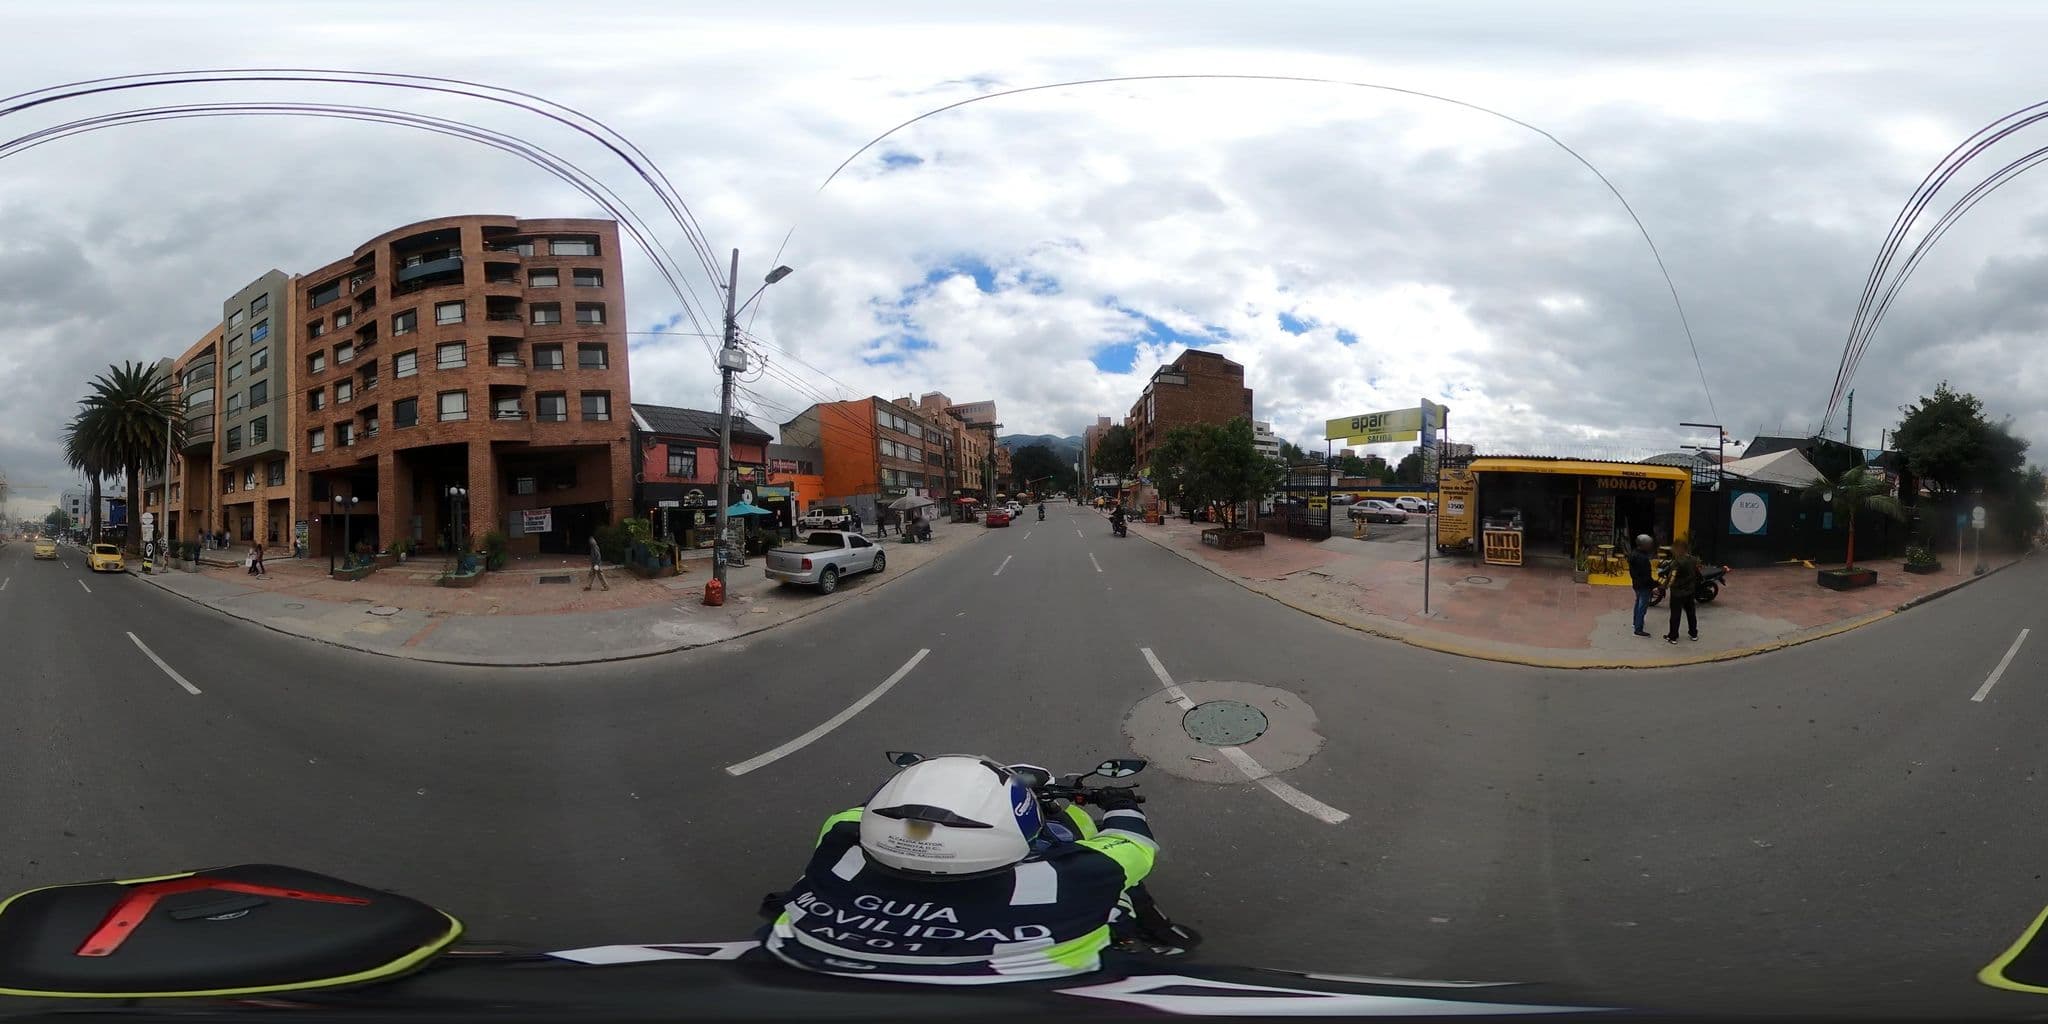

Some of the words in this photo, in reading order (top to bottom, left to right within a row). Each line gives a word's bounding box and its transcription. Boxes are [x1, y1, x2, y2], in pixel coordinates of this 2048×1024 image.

[1485, 532, 1520, 548] TINTO
[1486, 547, 1520, 560] GRATIS
[797, 891, 1052, 941] MOVILIDAD
[853, 894, 958, 923] GUÍA
